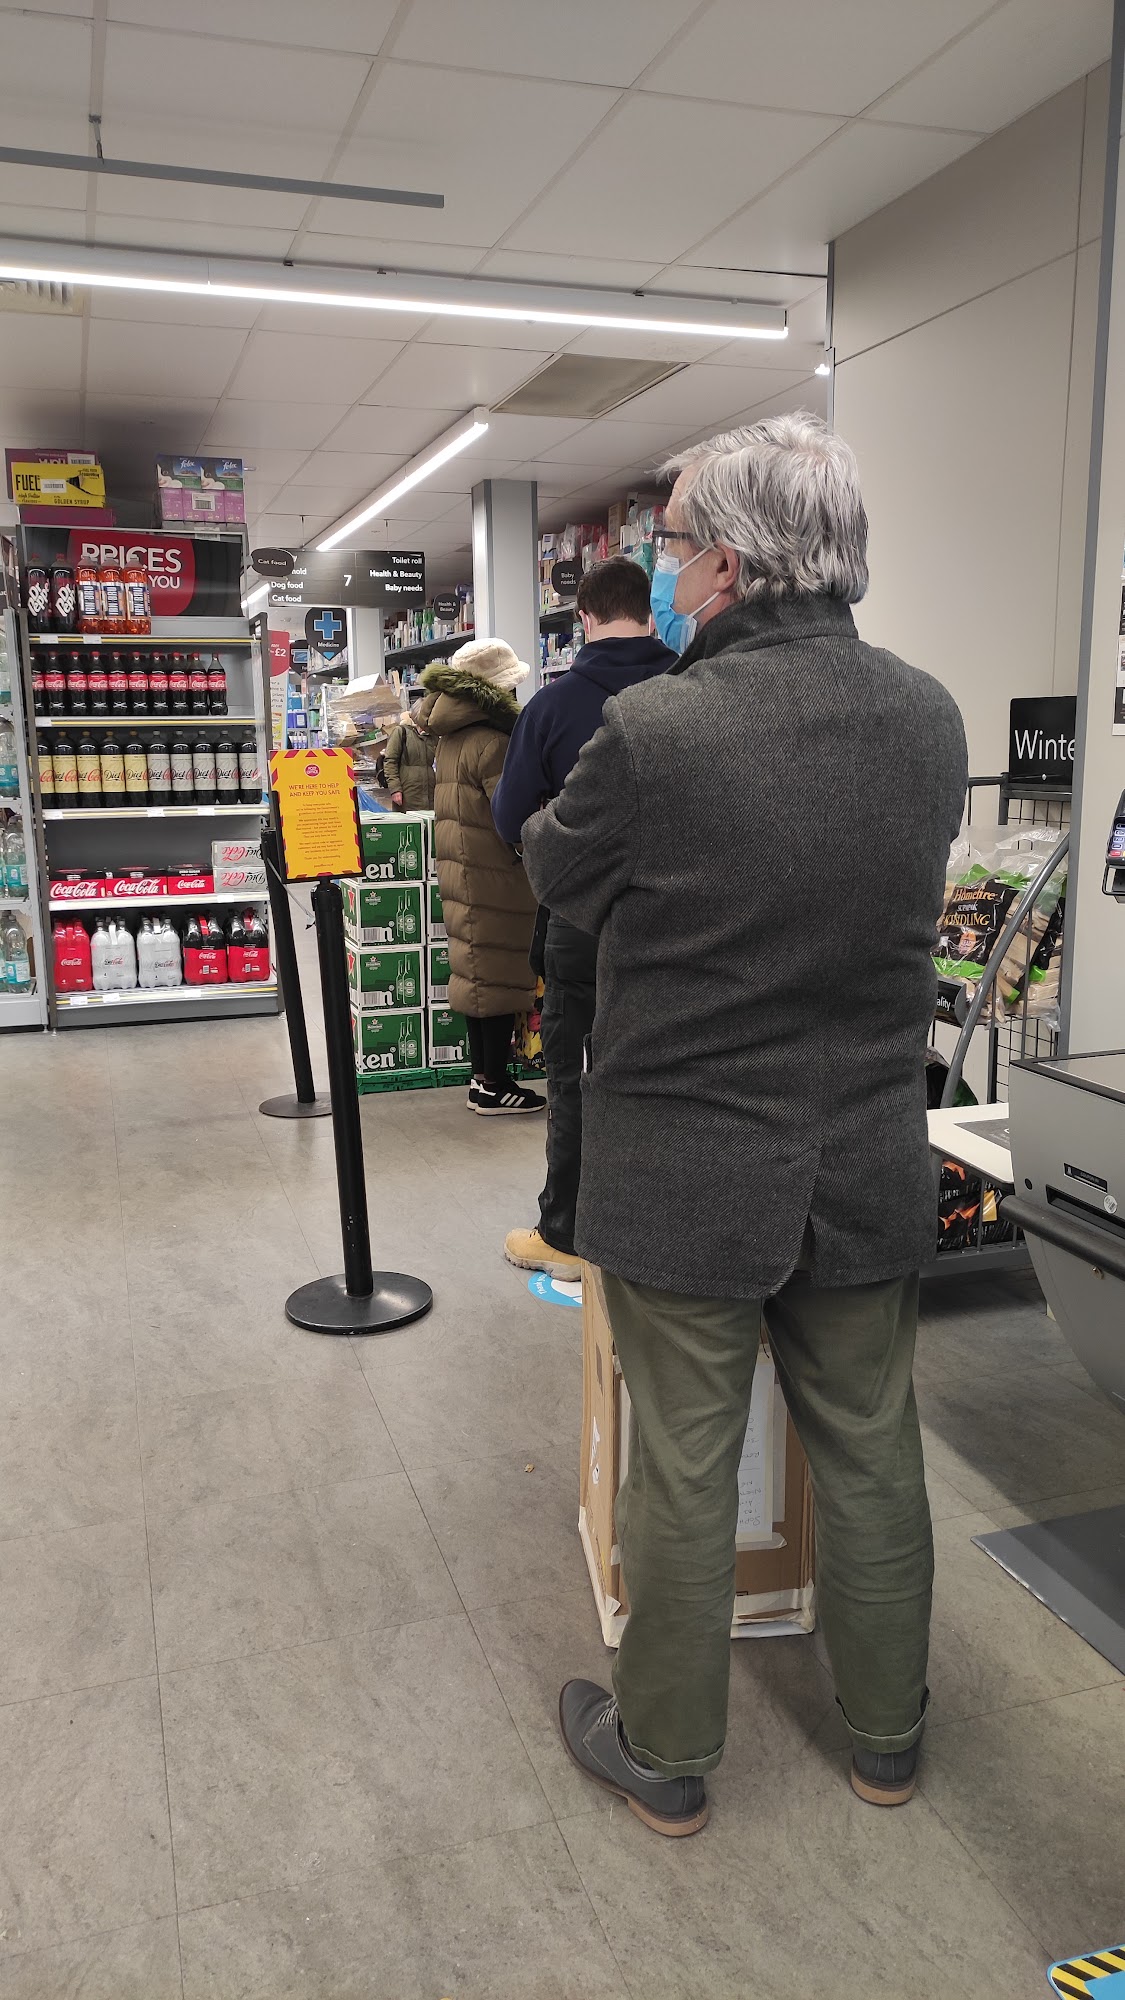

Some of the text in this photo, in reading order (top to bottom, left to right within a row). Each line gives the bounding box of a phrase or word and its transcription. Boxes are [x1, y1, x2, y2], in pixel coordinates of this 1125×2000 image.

[81, 543, 182, 573] PRICES
[391, 556, 423, 565] Toilet roll
[343, 574, 353, 587] 7
[369, 569, 423, 582] Health & Beauty
[560, 571, 575, 581] Baby
[148, 576, 181, 590] YOU
[271, 581, 304, 591] Dog food
[385, 583, 423, 594] Baby needs
[271, 594, 302, 603] Cat food
[103, 769, 121, 781] Diet
[127, 769, 144, 781] Diet
[944, 913, 991, 926] KINDLING
